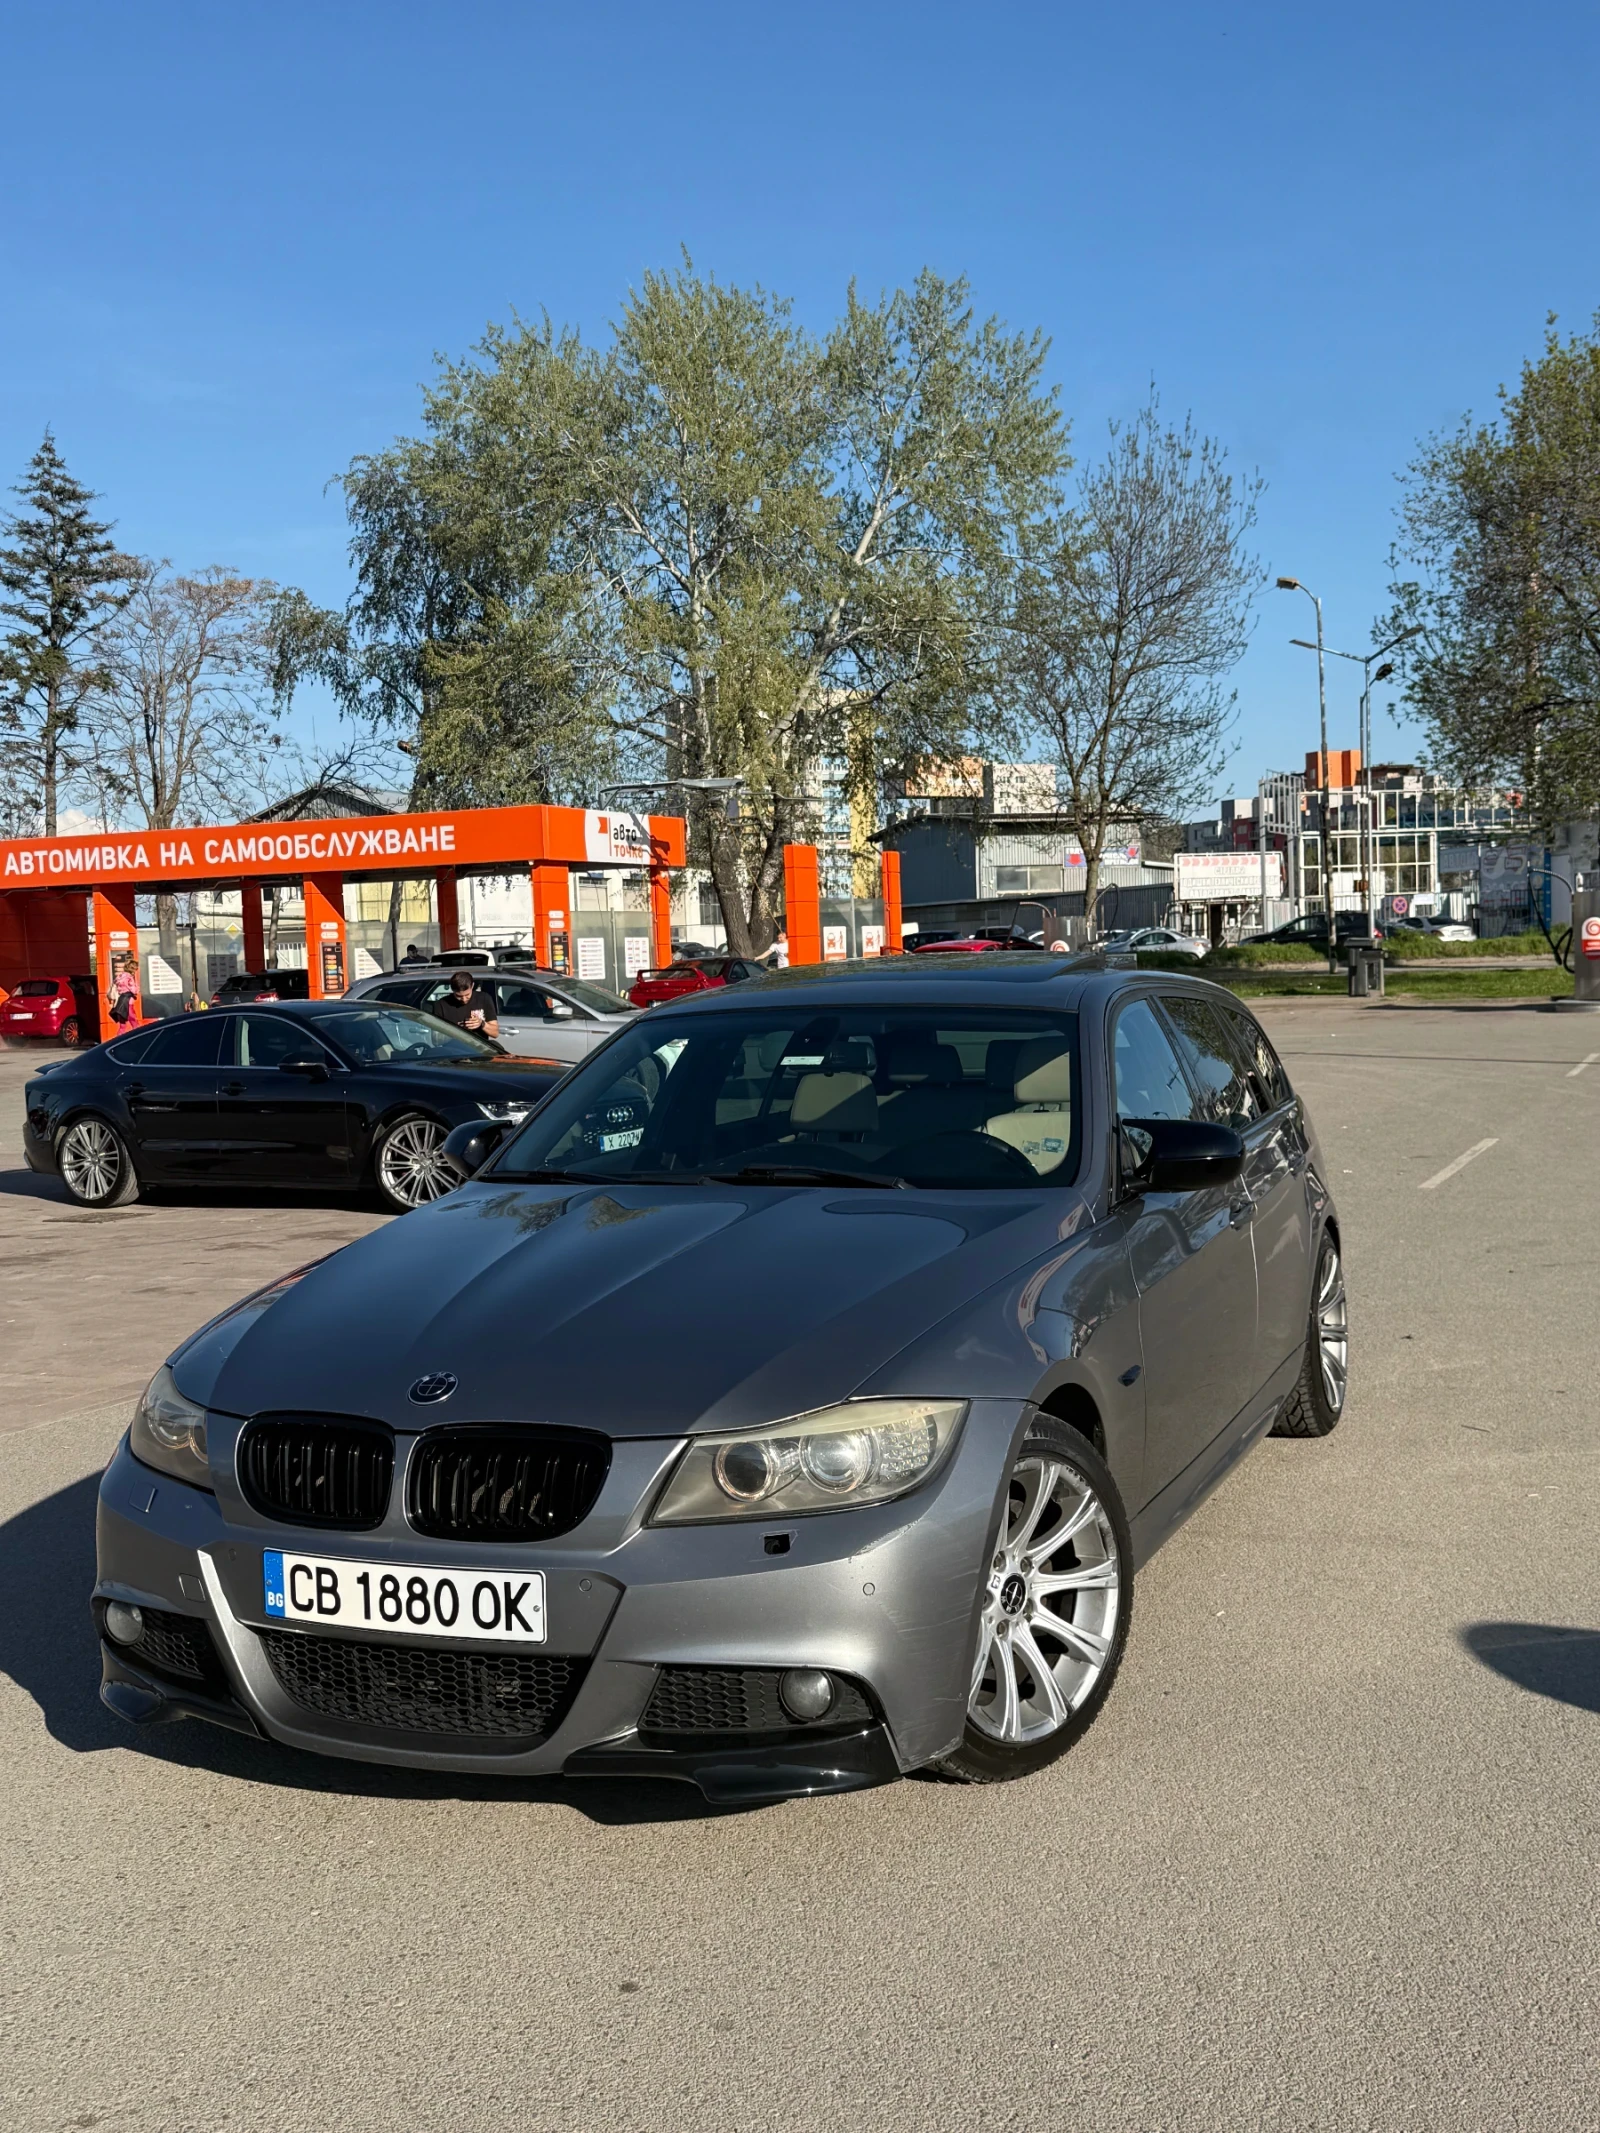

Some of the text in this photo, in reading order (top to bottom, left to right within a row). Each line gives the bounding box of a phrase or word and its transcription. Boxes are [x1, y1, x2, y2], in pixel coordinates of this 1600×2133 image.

[4, 825, 456, 876] АВТОМИВКА НА САМООБСЛУЖВАНЕ
[267, 1592, 284, 1608] BG
[289, 1563, 534, 1633] CB 1880 OK
